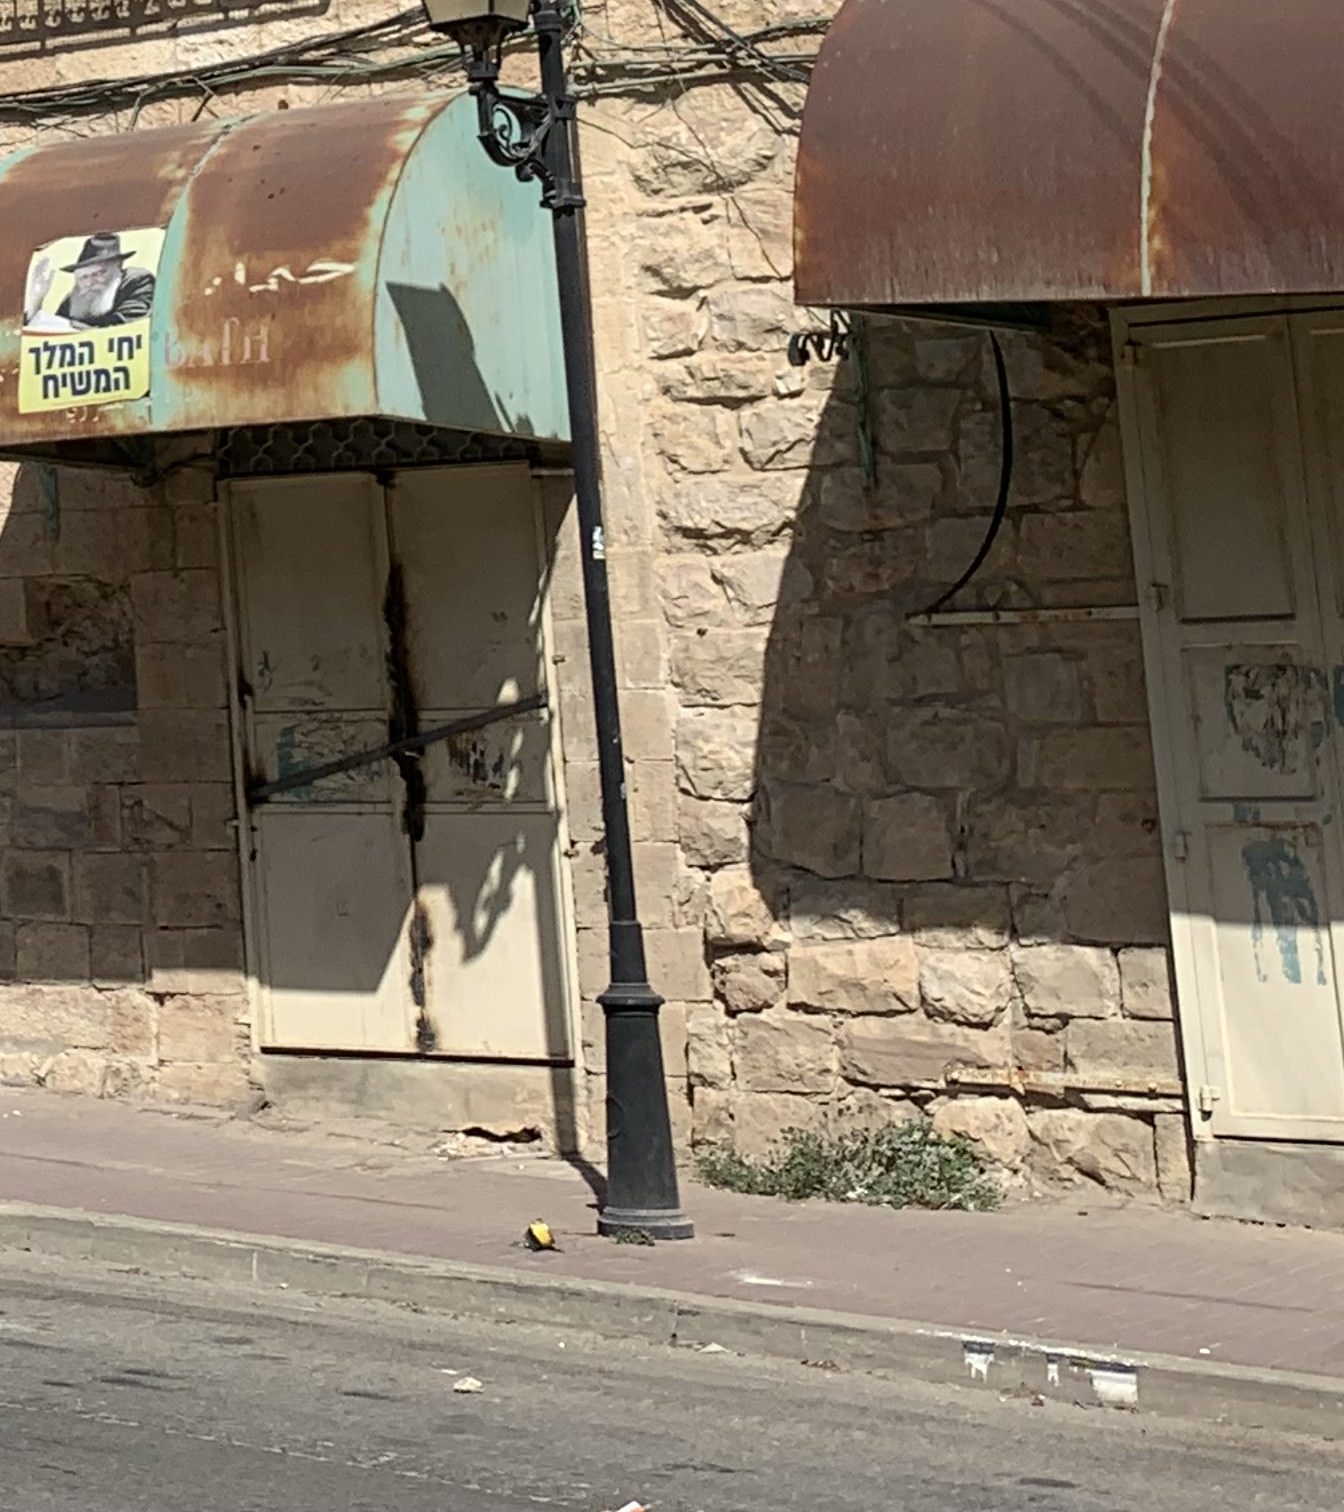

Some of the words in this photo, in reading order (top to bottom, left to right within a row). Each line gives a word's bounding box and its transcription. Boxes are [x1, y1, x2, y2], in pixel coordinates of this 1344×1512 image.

[28, 340, 94, 375] המלך
[108, 334, 142, 361] יחי
[42, 366, 131, 399] המשיח
